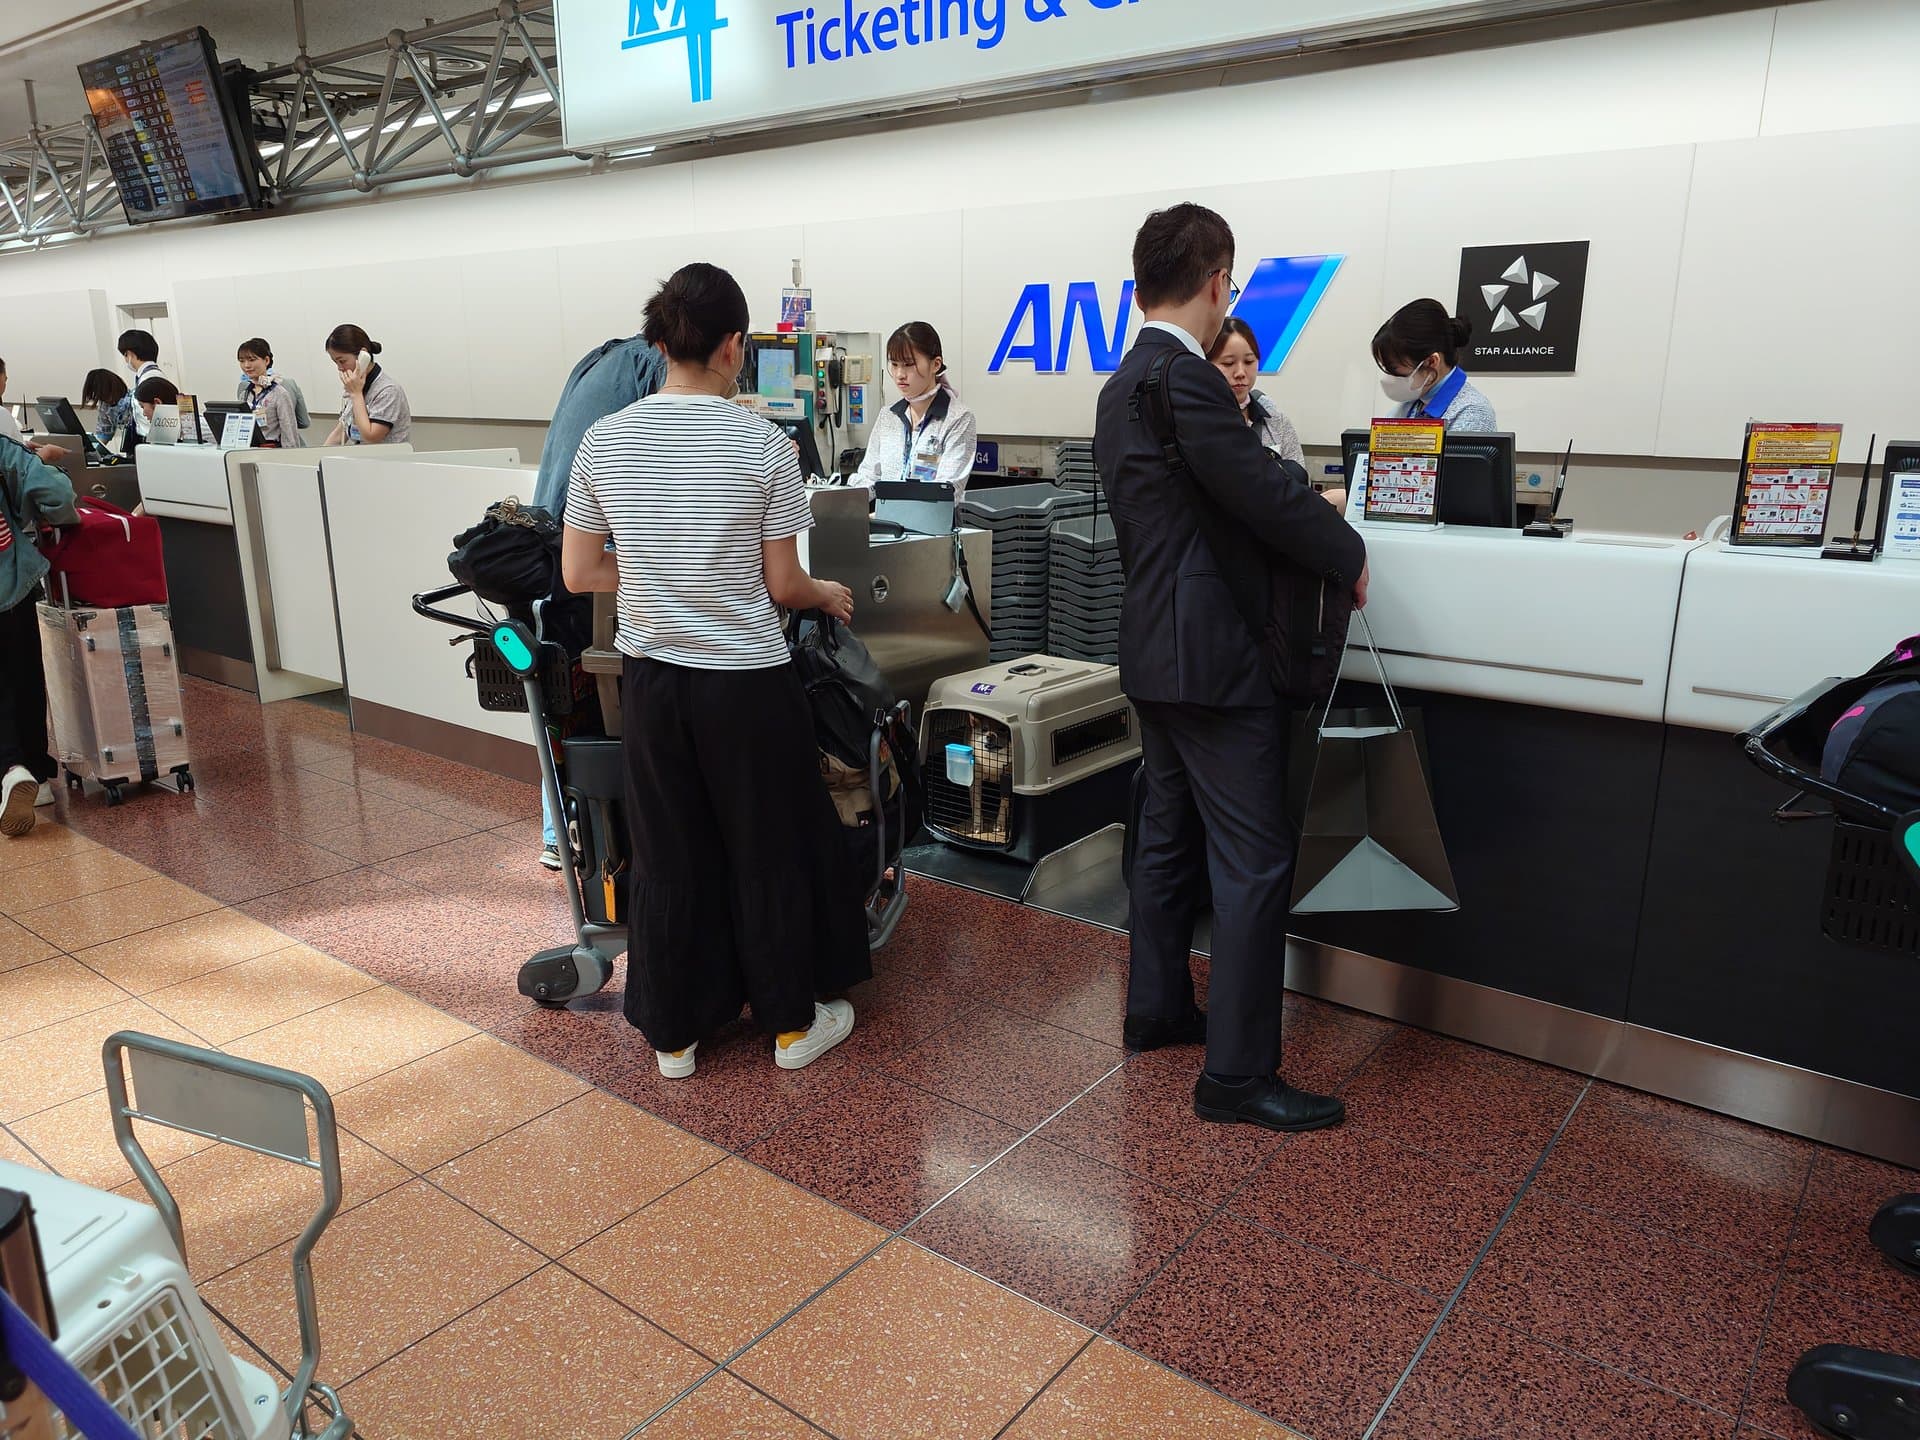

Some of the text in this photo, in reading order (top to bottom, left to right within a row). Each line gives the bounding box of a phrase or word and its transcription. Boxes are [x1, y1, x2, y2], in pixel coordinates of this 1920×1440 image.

[775, 0, 1006, 69] Ticketing
[987, 280, 1136, 374] AN
[1474, 346, 1555, 356] STAR ALLIANCE
[154, 417, 178, 427] CLOSED
